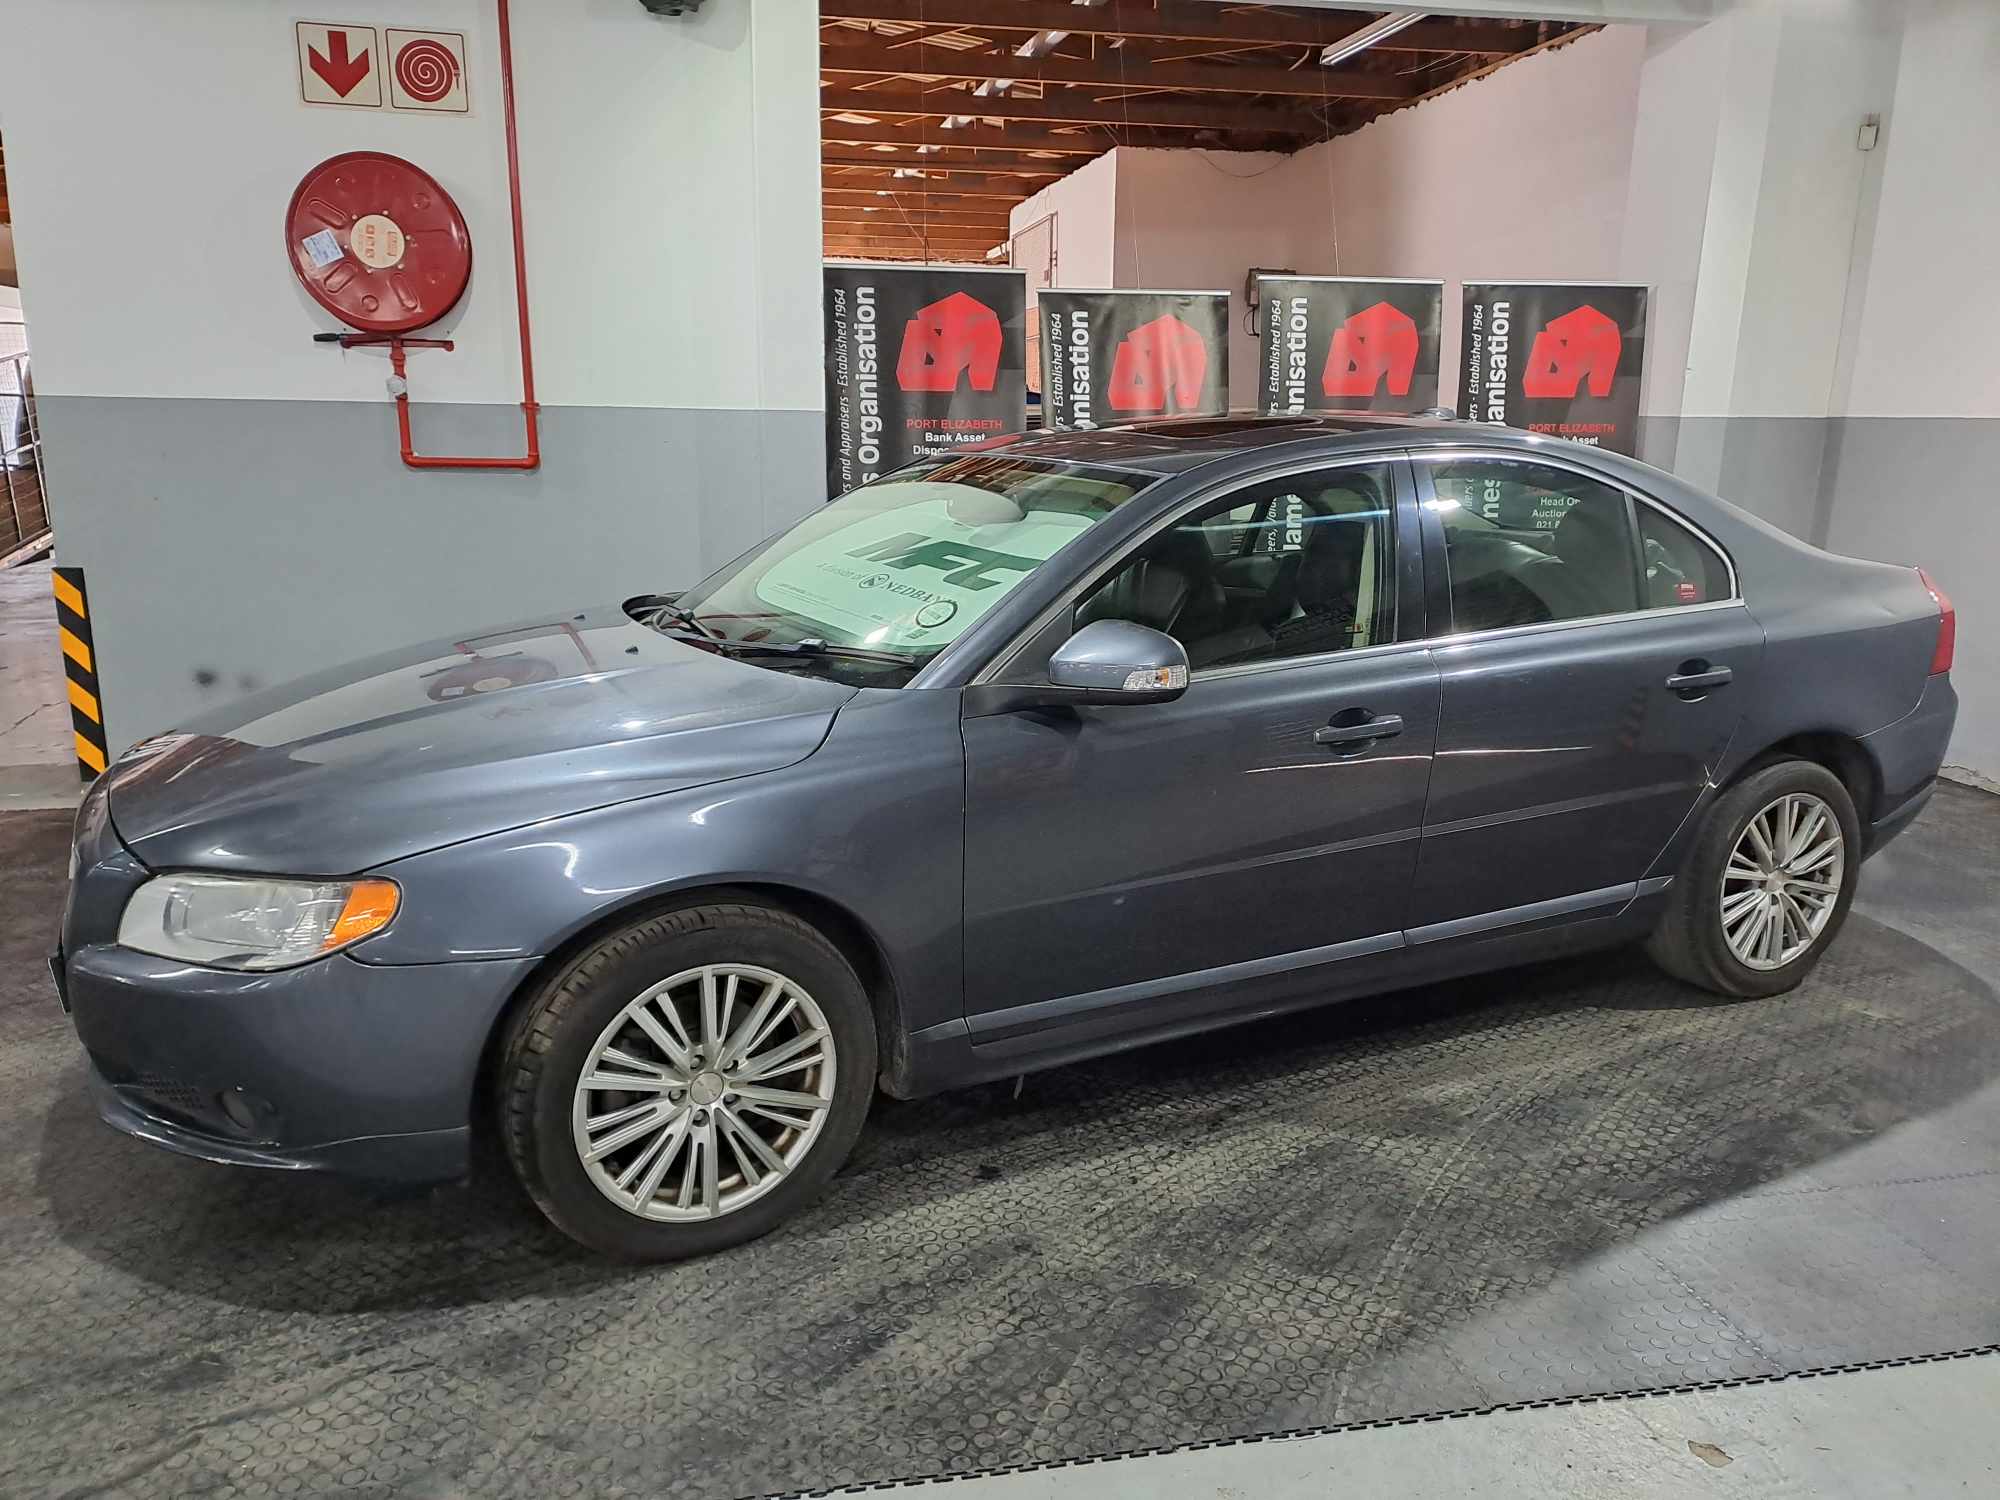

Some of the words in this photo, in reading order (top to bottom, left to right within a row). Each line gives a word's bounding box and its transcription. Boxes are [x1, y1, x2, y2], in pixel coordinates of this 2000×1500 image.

[833, 288, 847, 317] 1964
[1271, 299, 1281, 327] 1964
[1051, 312, 1062, 341] 1964
[1472, 304, 1483, 330] 1964
[835, 320, 848, 386] Established
[1269, 329, 1280, 393] Established
[1469, 333, 1481, 394] Established
[1051, 343, 1064, 407] Established
[838, 396, 853, 457] Appraisers
[907, 419, 937, 429] PORT
[940, 419, 1003, 429] ELIZABETH
[925, 432, 953, 442] Bank
[955, 432, 986, 442] Asset
[1529, 424, 1557, 432] PORT
[1560, 424, 1615, 432] ELIZABETH
[840, 458, 851, 480] and
[1540, 497, 1564, 506] Head
